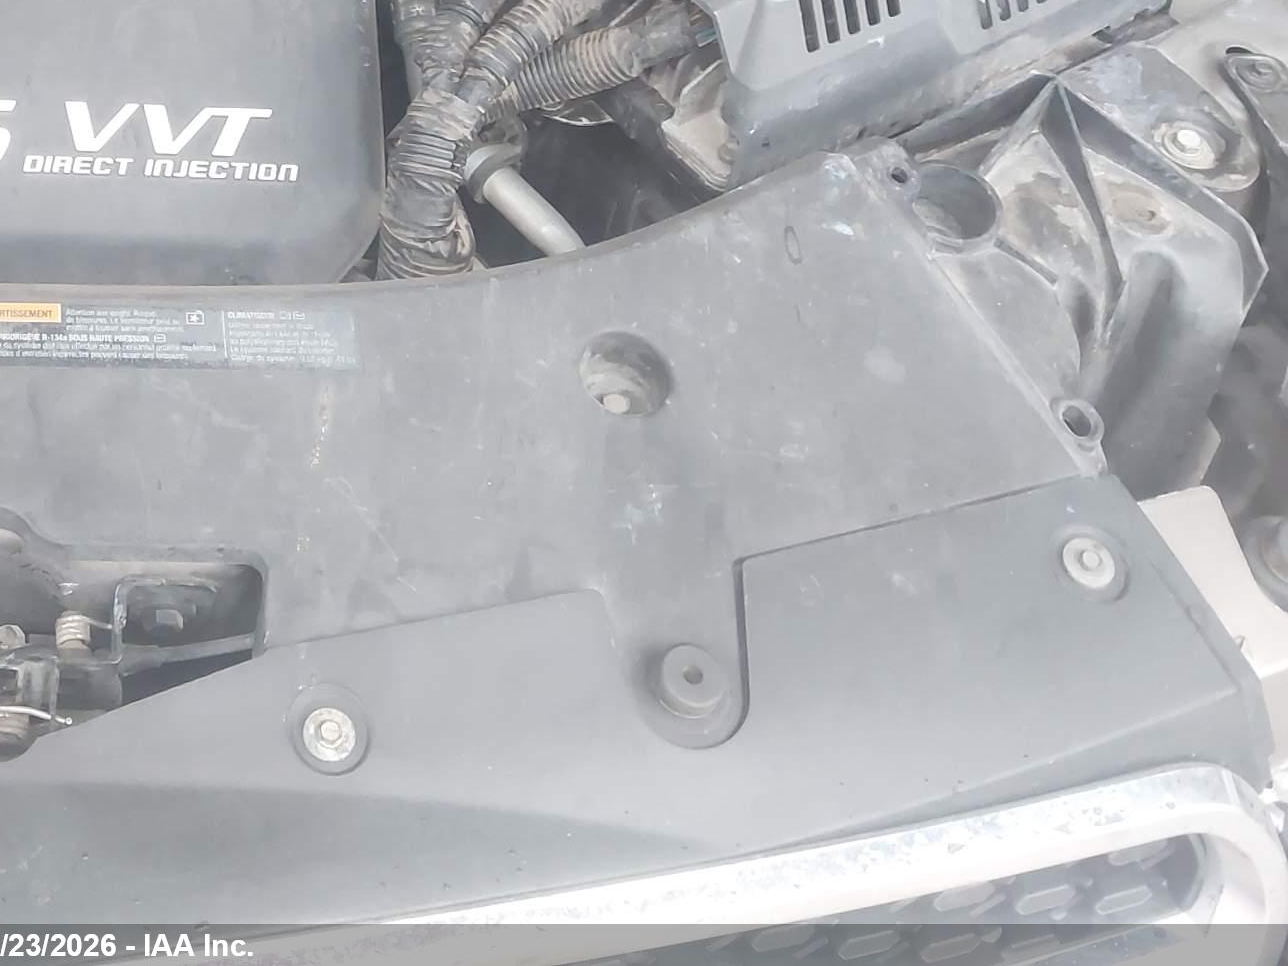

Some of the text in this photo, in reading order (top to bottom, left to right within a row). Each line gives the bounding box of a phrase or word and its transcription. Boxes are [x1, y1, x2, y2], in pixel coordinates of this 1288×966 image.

[64, 100, 273, 157] VVT
[23, 154, 299, 182] DIRECT INJECTION
